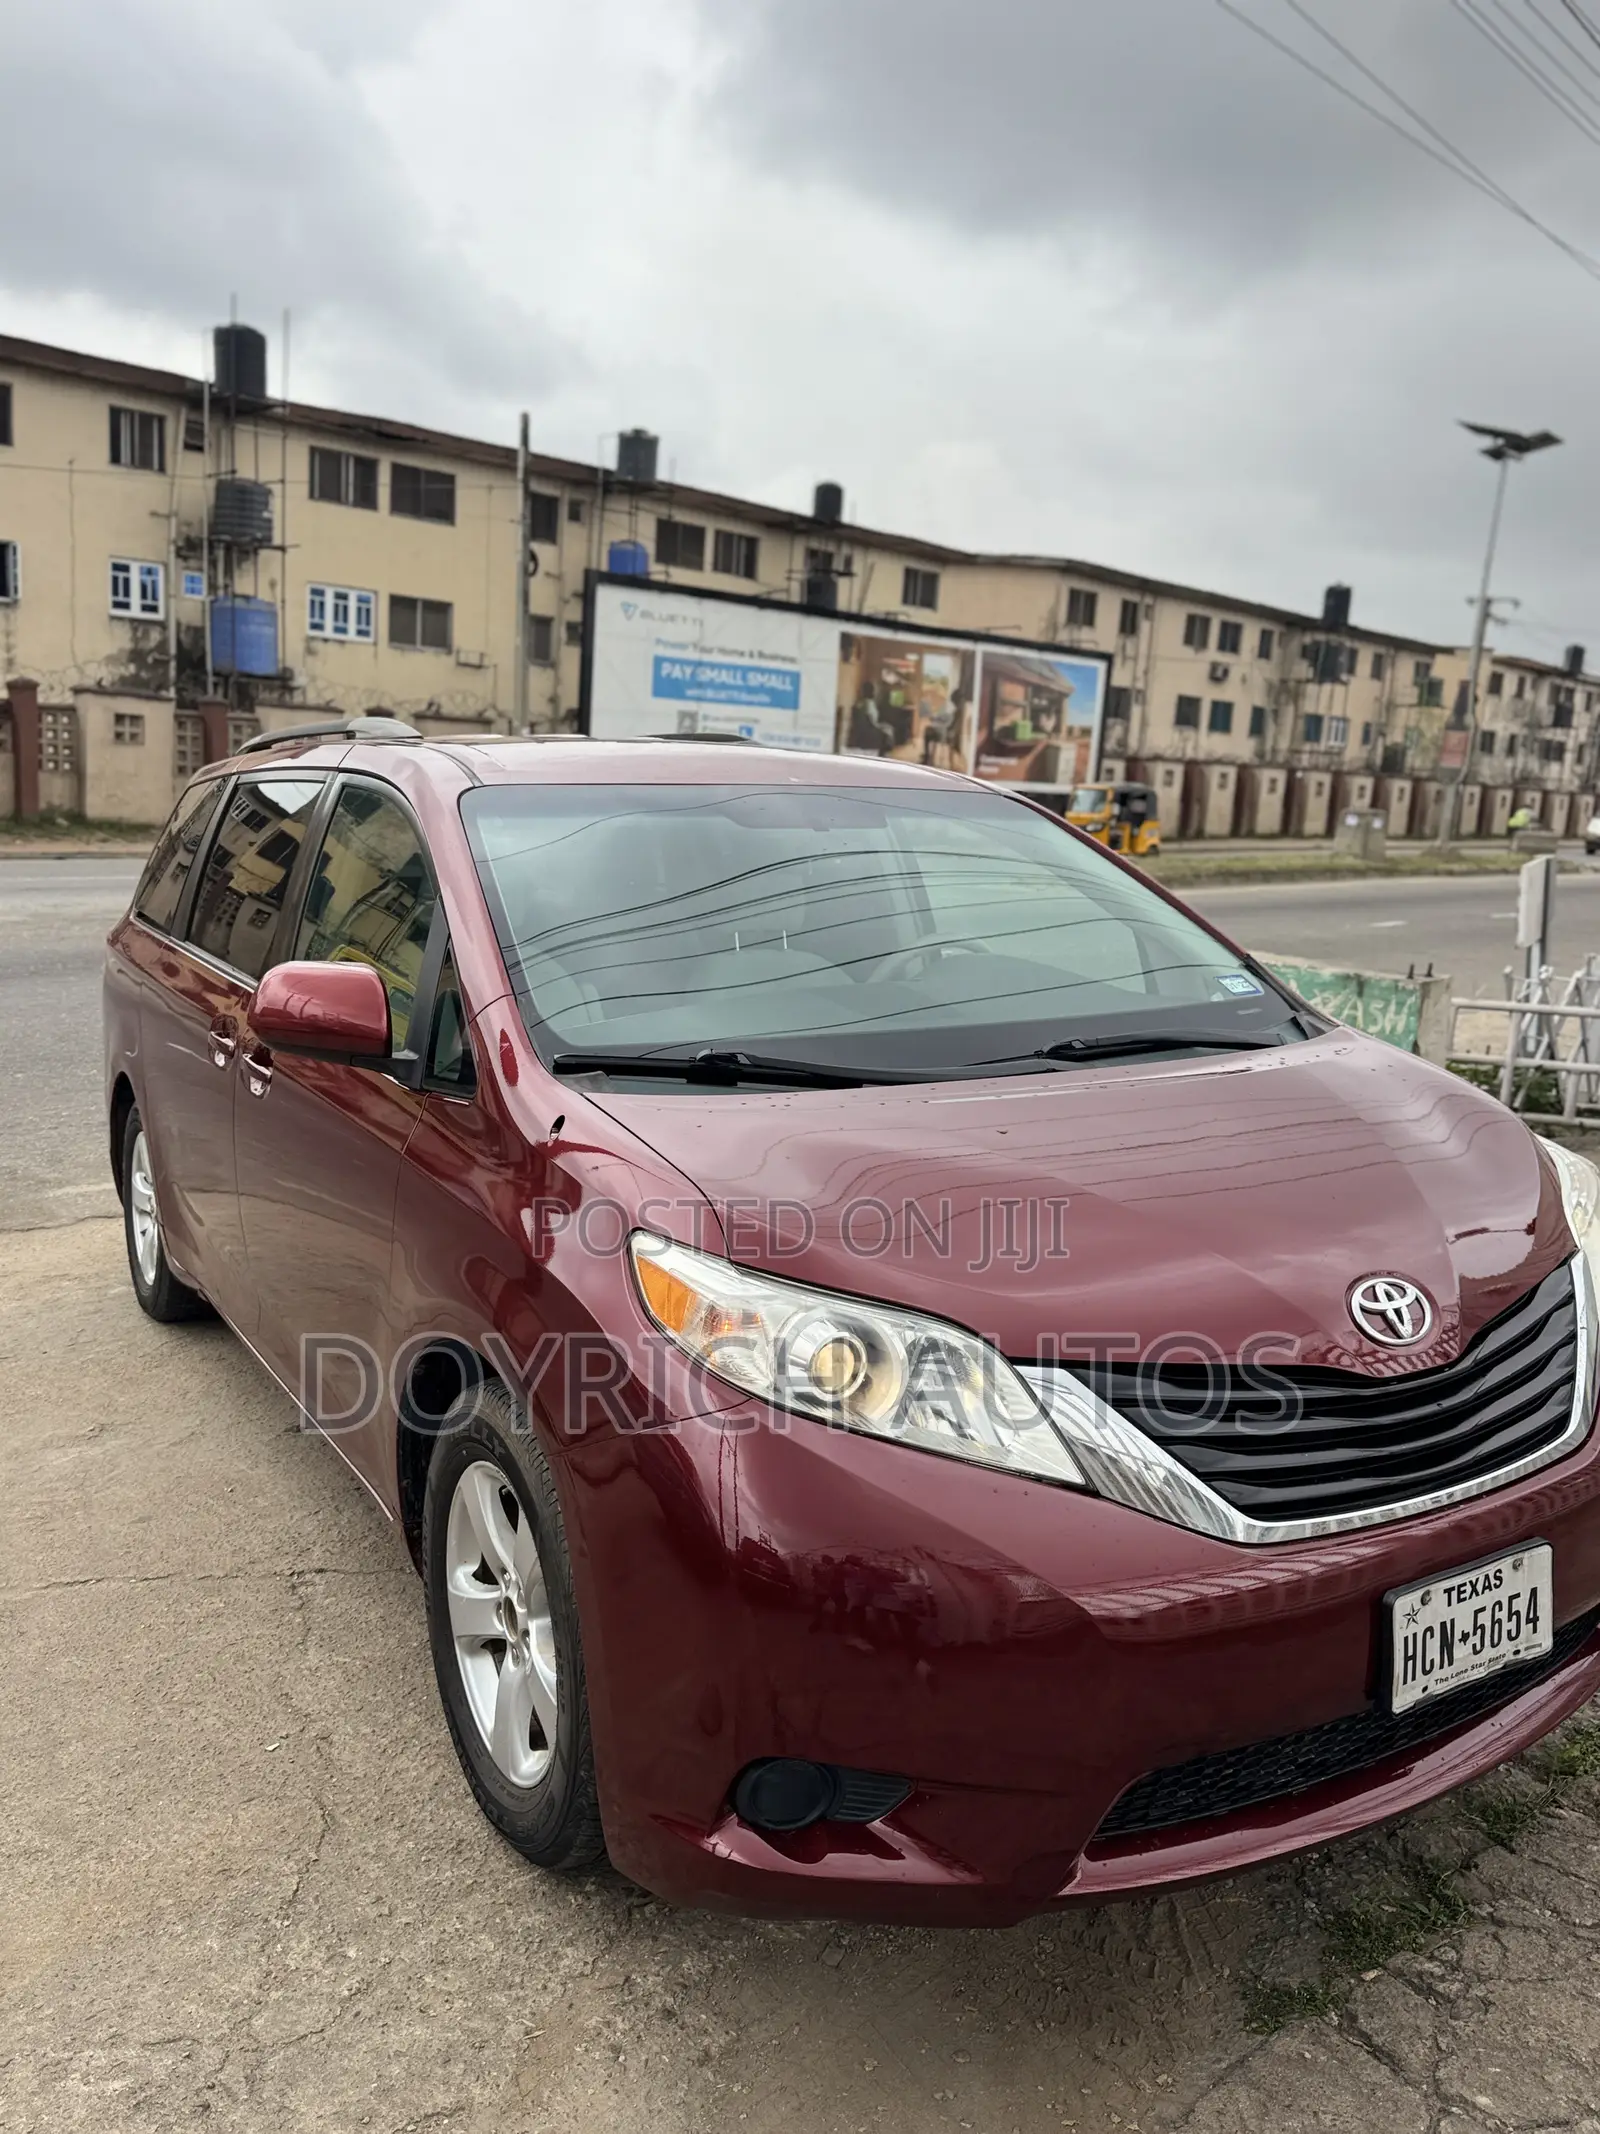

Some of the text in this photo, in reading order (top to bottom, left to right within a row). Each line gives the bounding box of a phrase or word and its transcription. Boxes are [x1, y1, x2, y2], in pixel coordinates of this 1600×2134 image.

[660, 661, 794, 691] PAY SMALL SMALL
[1443, 1568, 1504, 1607] TEXAS
[1434, 1651, 1507, 1685] The Lone Star State
